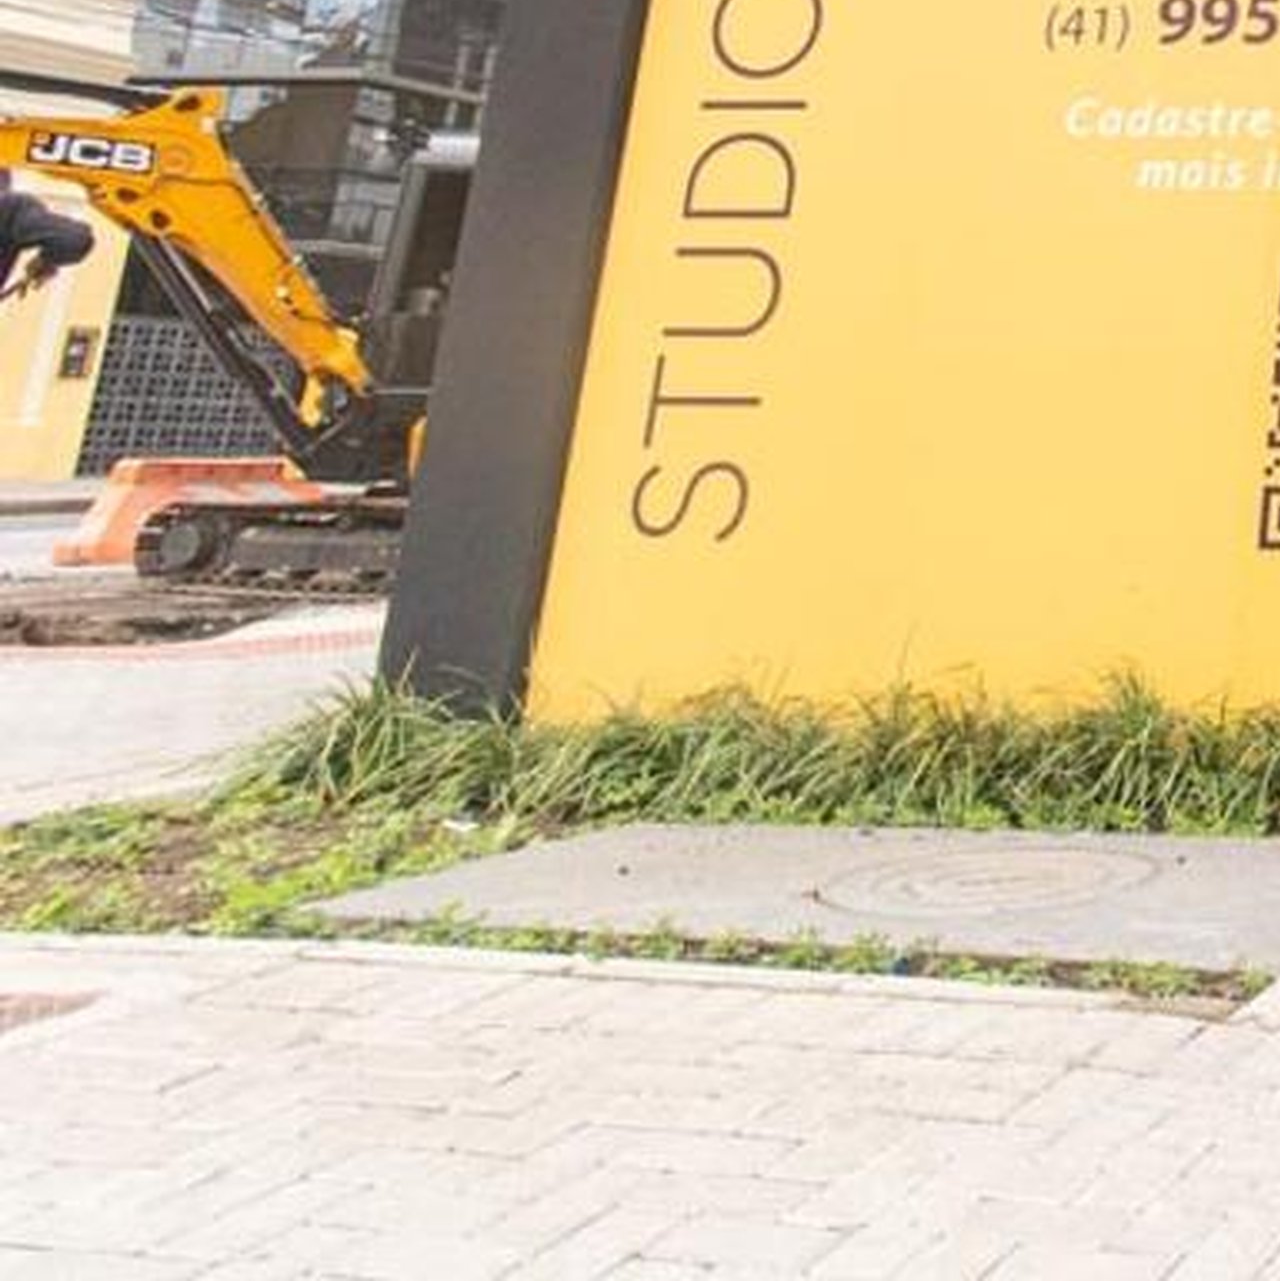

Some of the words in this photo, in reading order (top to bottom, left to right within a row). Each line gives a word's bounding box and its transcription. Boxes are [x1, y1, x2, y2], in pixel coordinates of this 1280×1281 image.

[1045, 5, 1132, 51] (41)
[30, 133, 153, 171] JCB
[1137, 152, 1247, 190] mais
